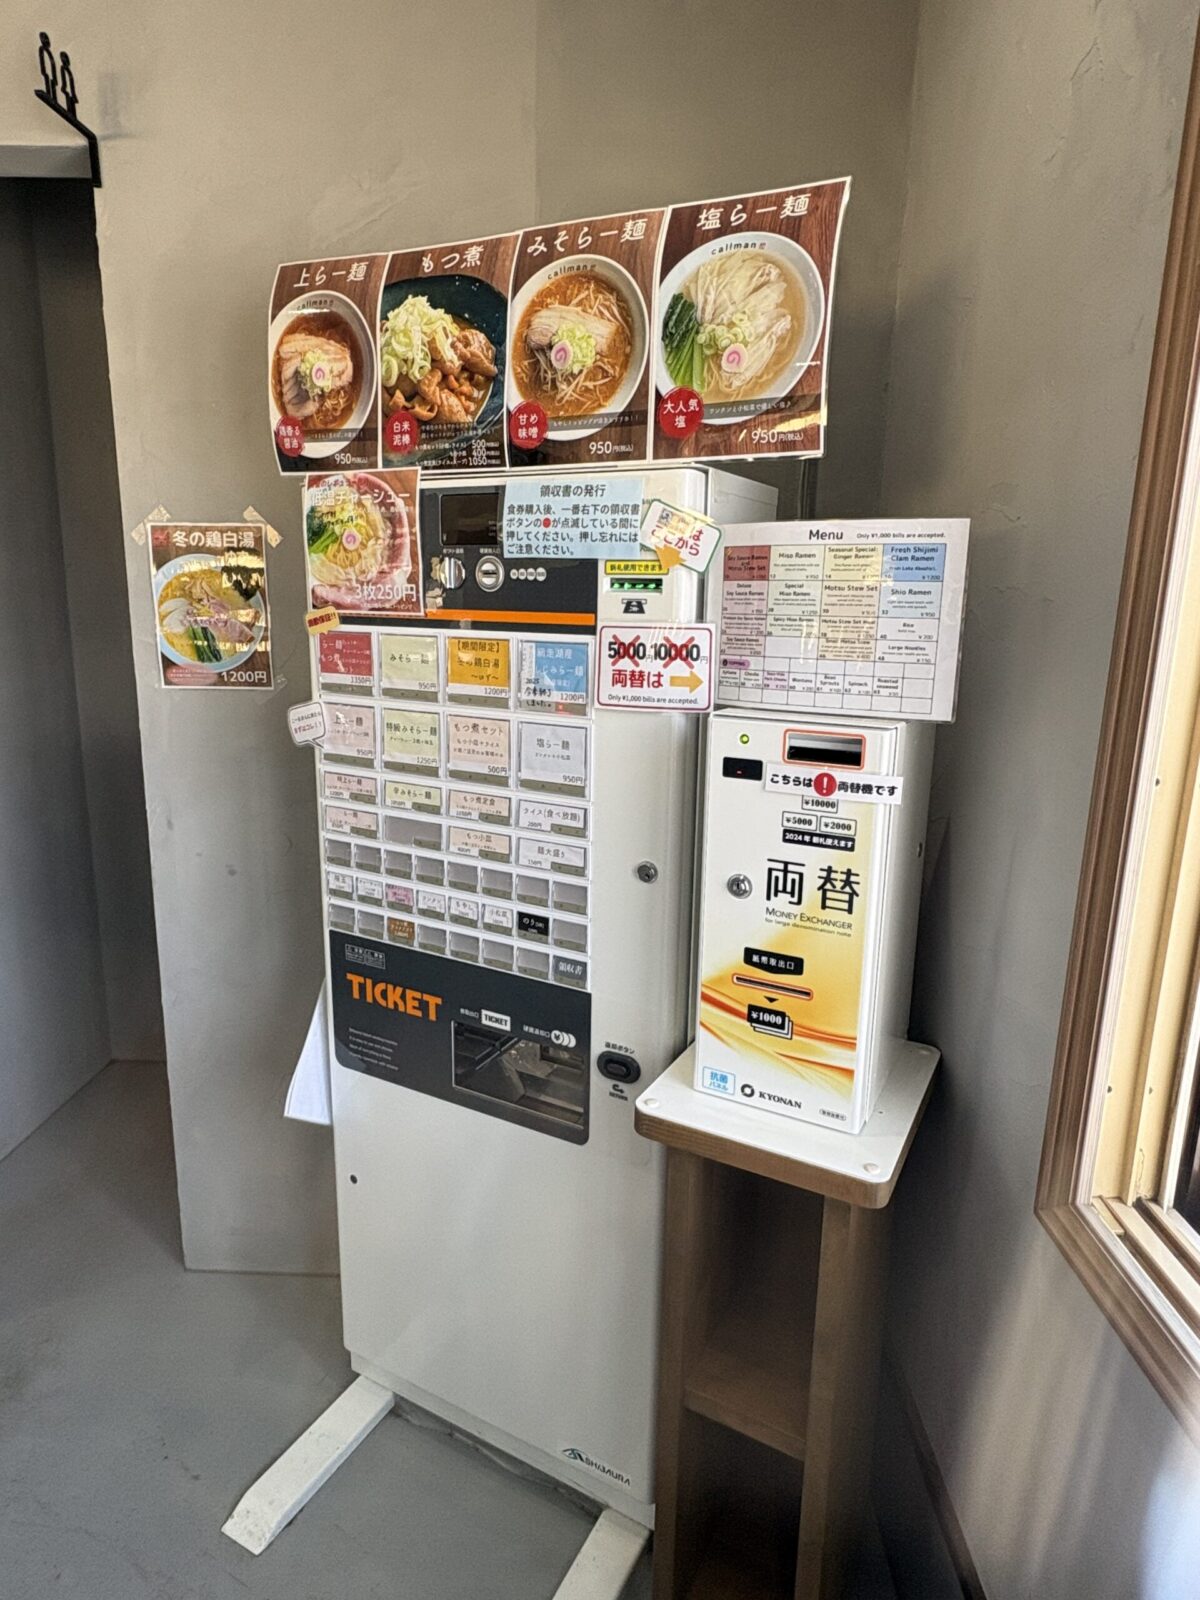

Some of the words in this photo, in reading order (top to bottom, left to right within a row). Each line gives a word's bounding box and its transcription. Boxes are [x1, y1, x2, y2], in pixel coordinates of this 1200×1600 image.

[697, 193, 811, 231] 塩らー麺
[527, 218, 648, 257] みそらー麺
[421, 245, 484, 273] もつ煮
[293, 261, 369, 288] 上らー麺
[663, 399, 699, 415] 大人気
[518, 413, 538, 425] 甘め
[675, 416, 686, 429] 塩
[540, 484, 606, 498] 領収書の発行
[506, 503, 640, 516] 食券購入後、一番右下の領収書
[172, 530, 255, 548] 冬の鶏白湯
[809, 529, 844, 540] Menu
[507, 544, 574, 555] ご注意ください。
[221, 671, 267, 683] 1200円
[612, 669, 664, 688] 両替は
[608, 694, 621, 702] Only
[770, 773, 813, 788] こちらは
[838, 781, 898, 796] 両替機です
[766, 858, 861, 915] 両替
[346, 972, 443, 1022] TICKET
[484, 1013, 508, 1027] TICKET
[758, 1091, 802, 1109] KYONAN
